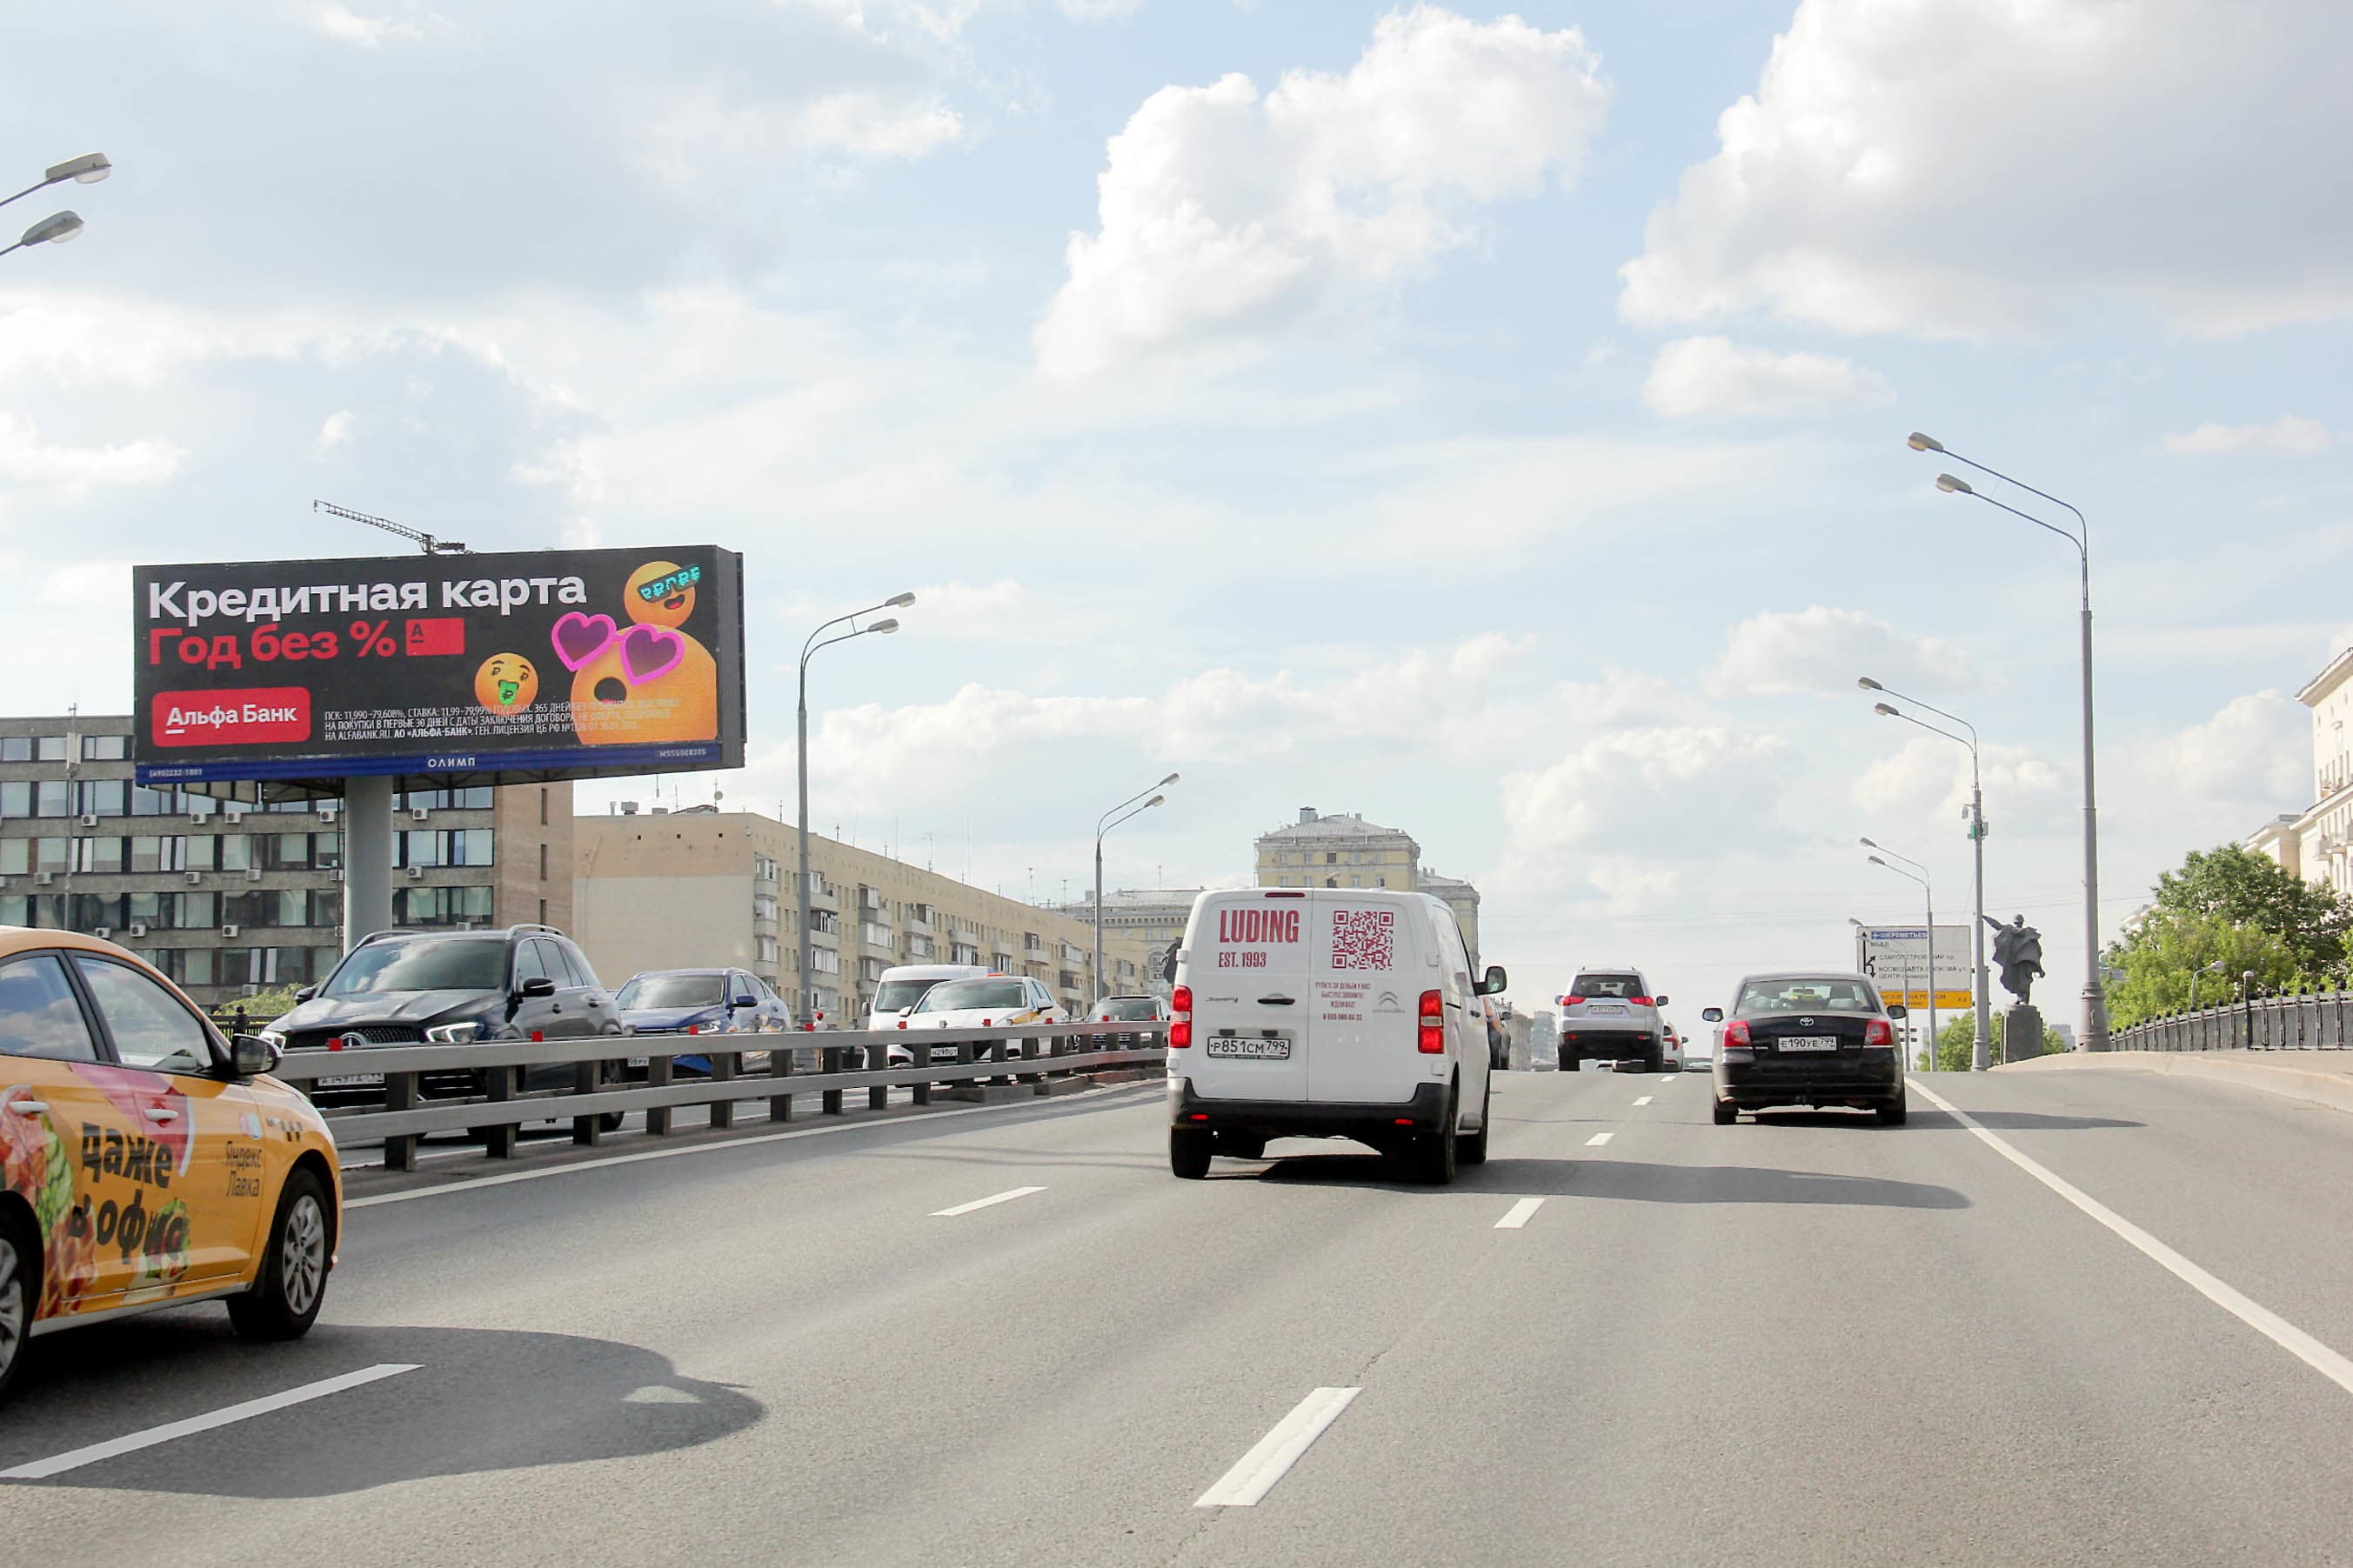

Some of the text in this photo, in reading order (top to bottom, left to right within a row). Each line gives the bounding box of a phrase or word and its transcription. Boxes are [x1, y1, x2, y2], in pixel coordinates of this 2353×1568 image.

[150, 575, 586, 627] Кредитная карта
[150, 620, 396, 670] Год без %
[165, 704, 297, 734] Альфа Банк
[324, 711, 342, 720] ПСК:
[408, 707, 438, 717] СТАВКА:
[534, 703, 547, 713] 365
[550, 701, 571, 712] ДНЕЙ
[324, 721, 336, 731] НА
[338, 719, 375, 731] ПОКУПКИ
[376, 719, 382, 729] В
[383, 718, 414, 729] ПЕРВЫЕ
[417, 717, 425, 727] 30
[426, 716, 448, 727] ДНЕЙ
[450, 717, 455, 726] С
[457, 716, 478, 727] ДАТЫ
[480, 713, 533, 725] ЗАКЛЮЧЕНИЯ
[324, 731, 336, 741] НА
[394, 729, 405, 738] АО
[475, 725, 491, 736] ГЕН.
[493, 724, 534, 735] ЛИЦЕНЗИЯ
[536, 724, 547, 734] ЦБ
[549, 723, 559, 733] РФ
[427, 757, 476, 768] ОЛИМП
[1220, 910, 1300, 944] LUDING
[1219, 951, 1267, 968] EST. 1993
[82, 1122, 173, 1189] даже
[225, 1140, 264, 1171] Яндекс
[226, 1171, 260, 1198] Лавка
